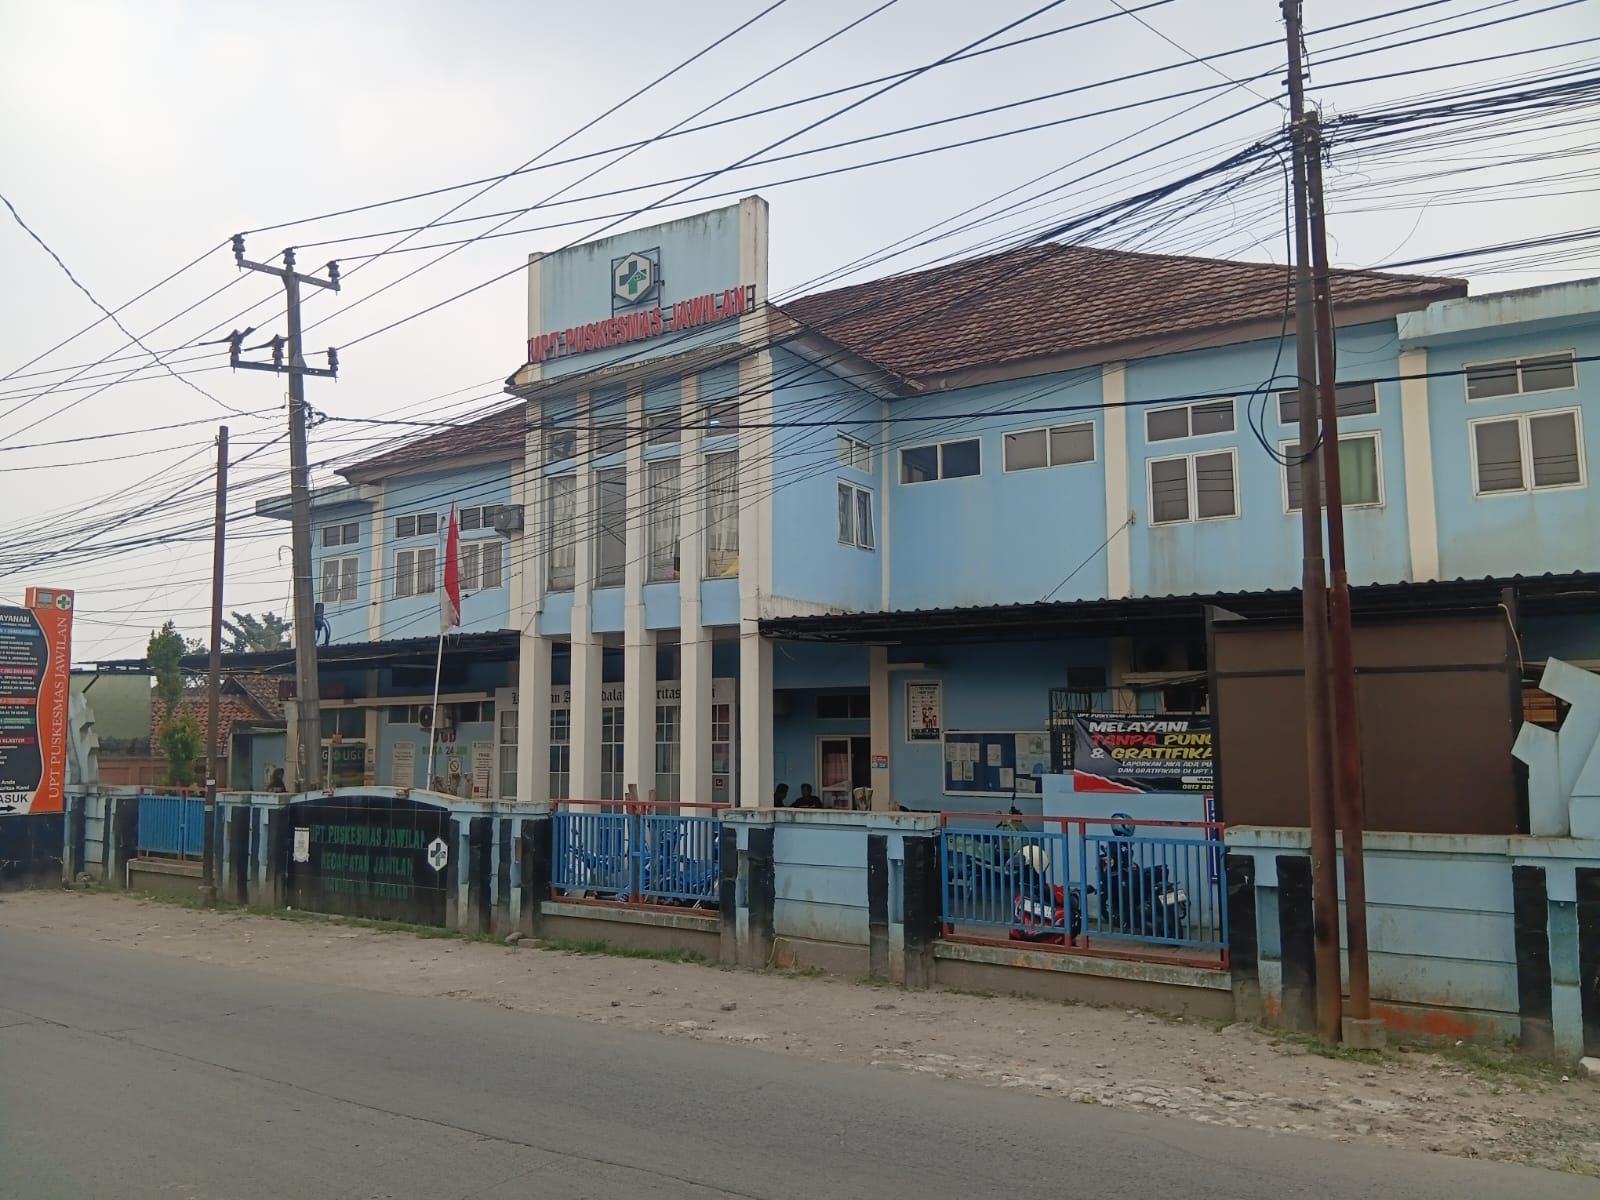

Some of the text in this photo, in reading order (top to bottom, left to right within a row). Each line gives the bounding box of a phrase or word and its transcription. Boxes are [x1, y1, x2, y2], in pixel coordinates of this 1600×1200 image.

[530, 285, 748, 361] UPT PUSKESMAS JAWILAN
[656, 688, 681, 700] ritas
[49, 616, 68, 799] UPT PUSKESMAS JAWILAN
[1088, 721, 1190, 732] MELAYANI
[1091, 733, 1158, 746] TANPA
[1090, 748, 1105, 759] &
